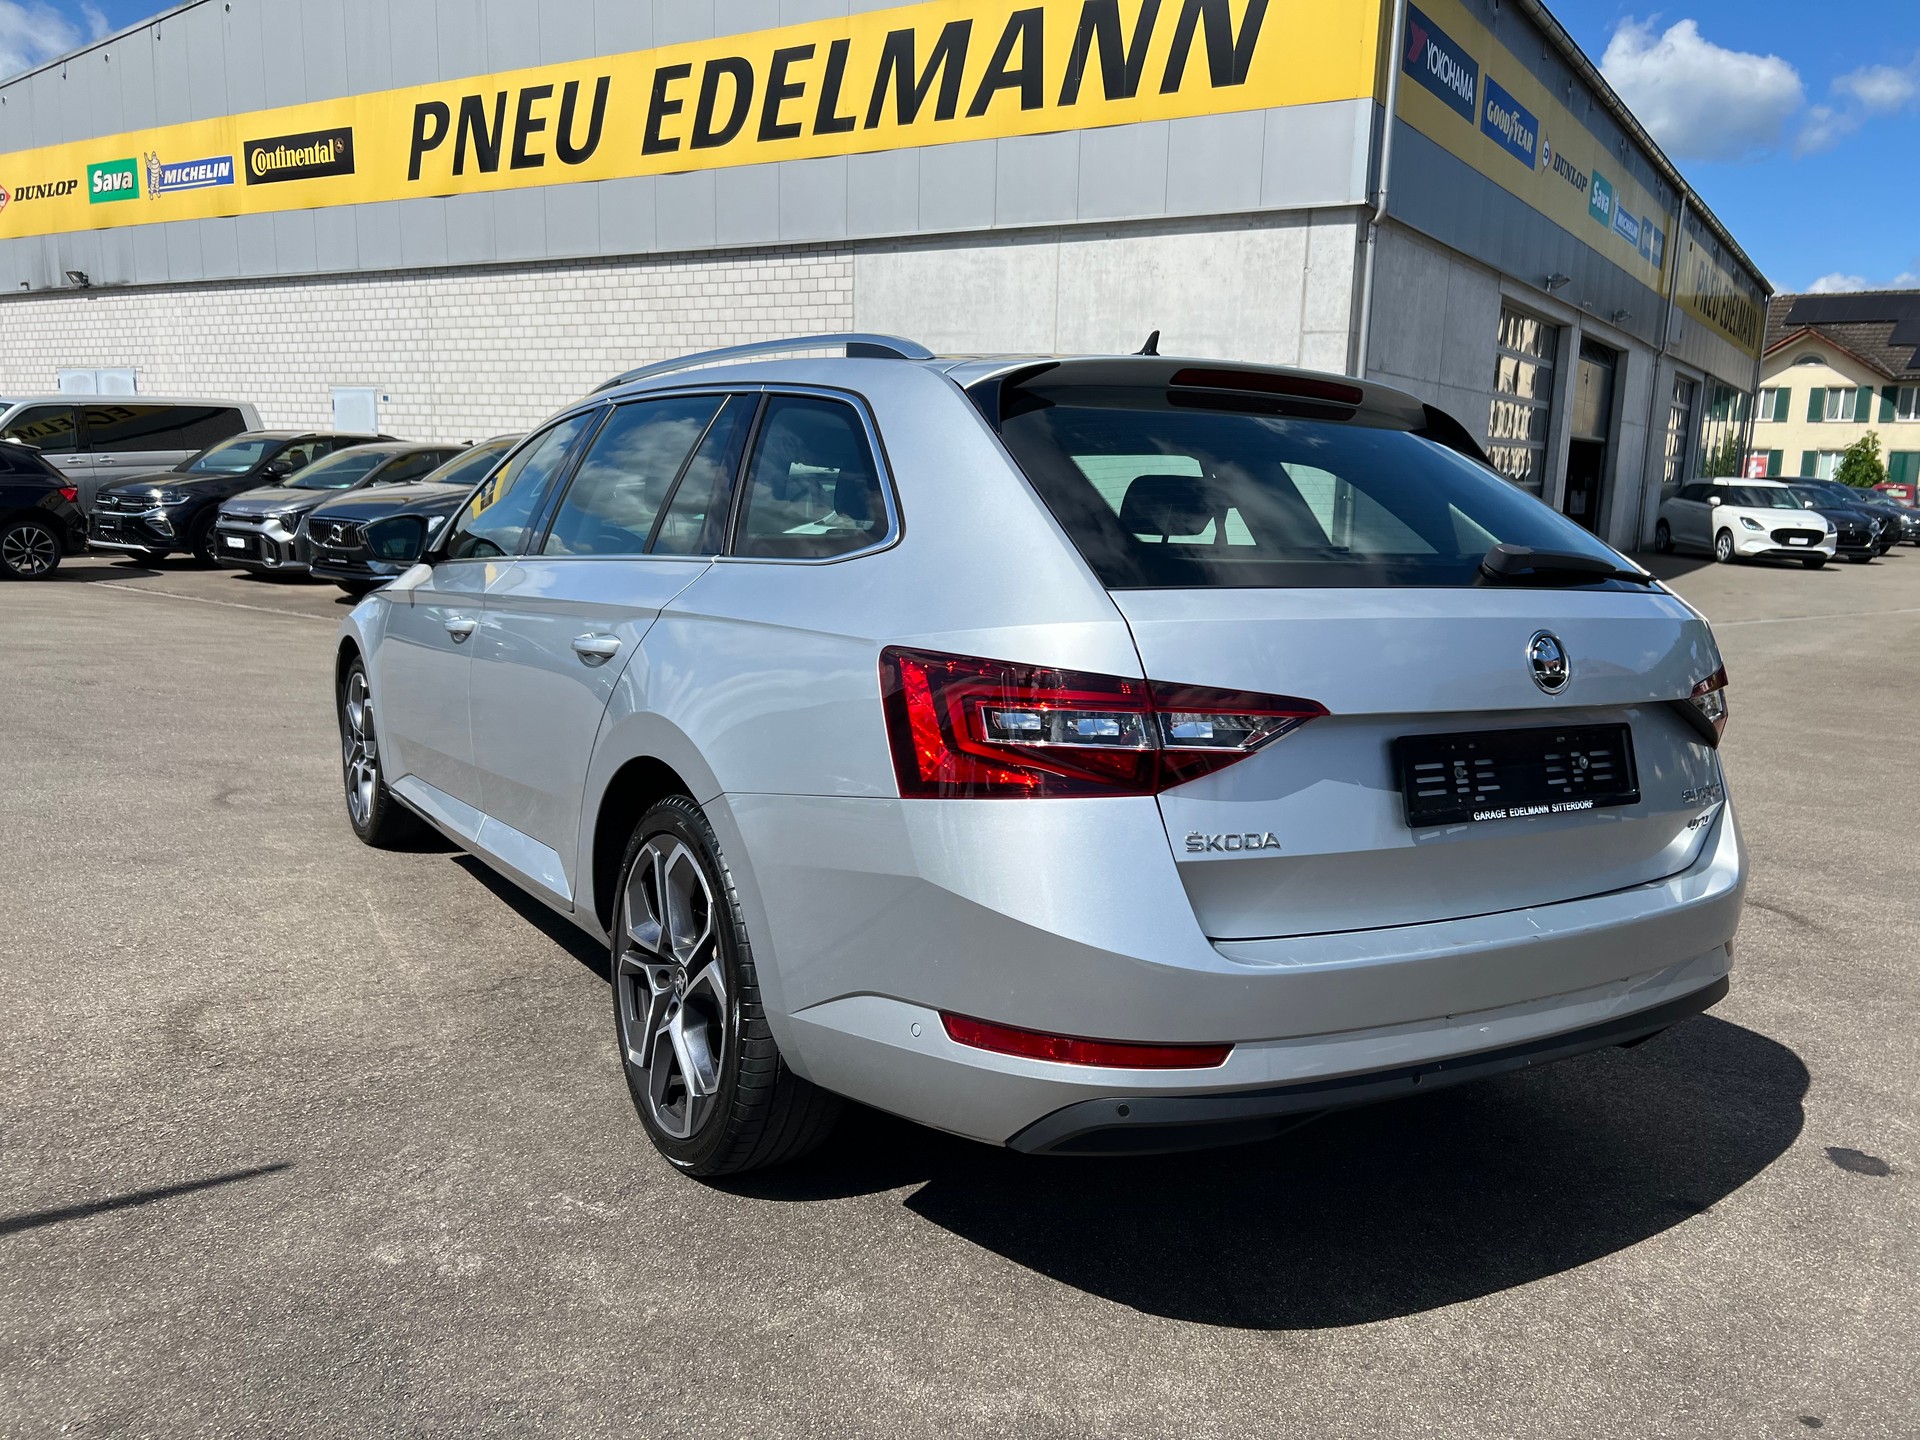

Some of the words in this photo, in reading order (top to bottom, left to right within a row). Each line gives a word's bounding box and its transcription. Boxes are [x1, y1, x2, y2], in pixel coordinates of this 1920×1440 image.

[407, 76, 611, 181] PNEU
[641, 0, 1269, 156] EDELMANN
[1426, 38, 1473, 106] YOKOHAMA
[1487, 100, 1534, 154] GOODYEAR
[163, 162, 231, 184] MICHELIN
[251, 138, 336, 177] Continental
[1553, 152, 1588, 193] DUNLOP
[14, 179, 78, 202] DUNLOP
[93, 170, 134, 194] Sava
[1592, 180, 1610, 215] Sava
[1694, 260, 1722, 322] PNEU
[1473, 809, 1507, 821] GARAGE
[1509, 804, 1549, 817] EDELMANN
[1551, 799, 1594, 813] SITTERDORF
[1184, 830, 1282, 853] ŠKODA
